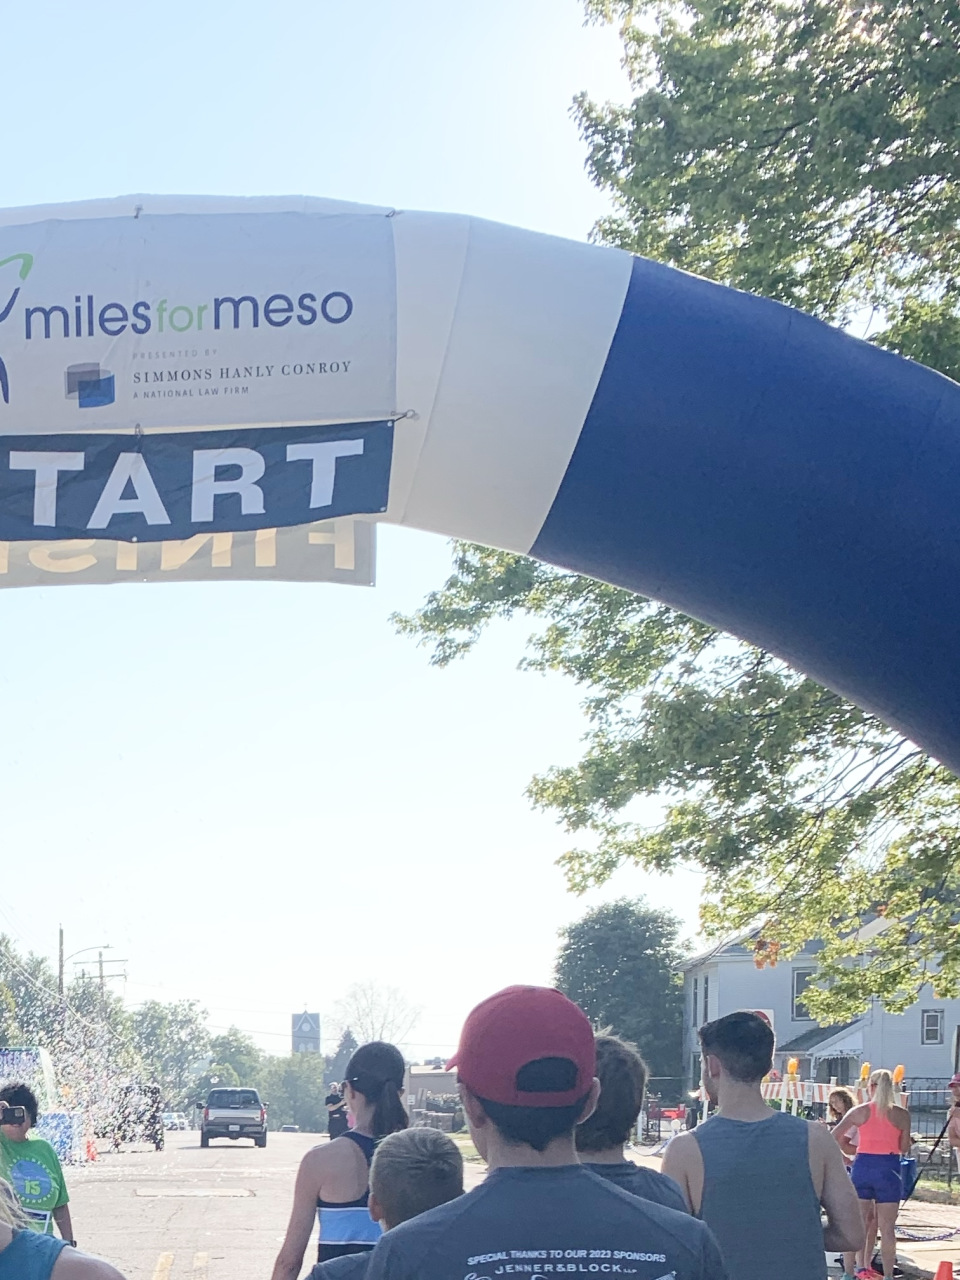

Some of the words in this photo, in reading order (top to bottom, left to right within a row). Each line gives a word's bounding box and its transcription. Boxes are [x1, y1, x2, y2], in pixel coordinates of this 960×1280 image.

[132, 349, 198, 361] PRESENTED
[204, 348, 218, 357] BY
[133, 368, 213, 384] SIMMONS
[219, 365, 275, 380] HANLY
[281, 360, 352, 377] CONROY
[133, 391, 139, 399] A
[143, 389, 194, 399] NATIONAL
[198, 387, 219, 396] LAW
[224, 386, 249, 395] FIRM
[467, 1251, 509, 1265] SPECIAL
[509, 1250, 547, 1259] THANKS
[548, 1250, 563, 1259] TO
[564, 1250, 587, 1258] OUR
[589, 1250, 612, 1258] 2023
[613, 1250, 667, 1262] SPONSORS
